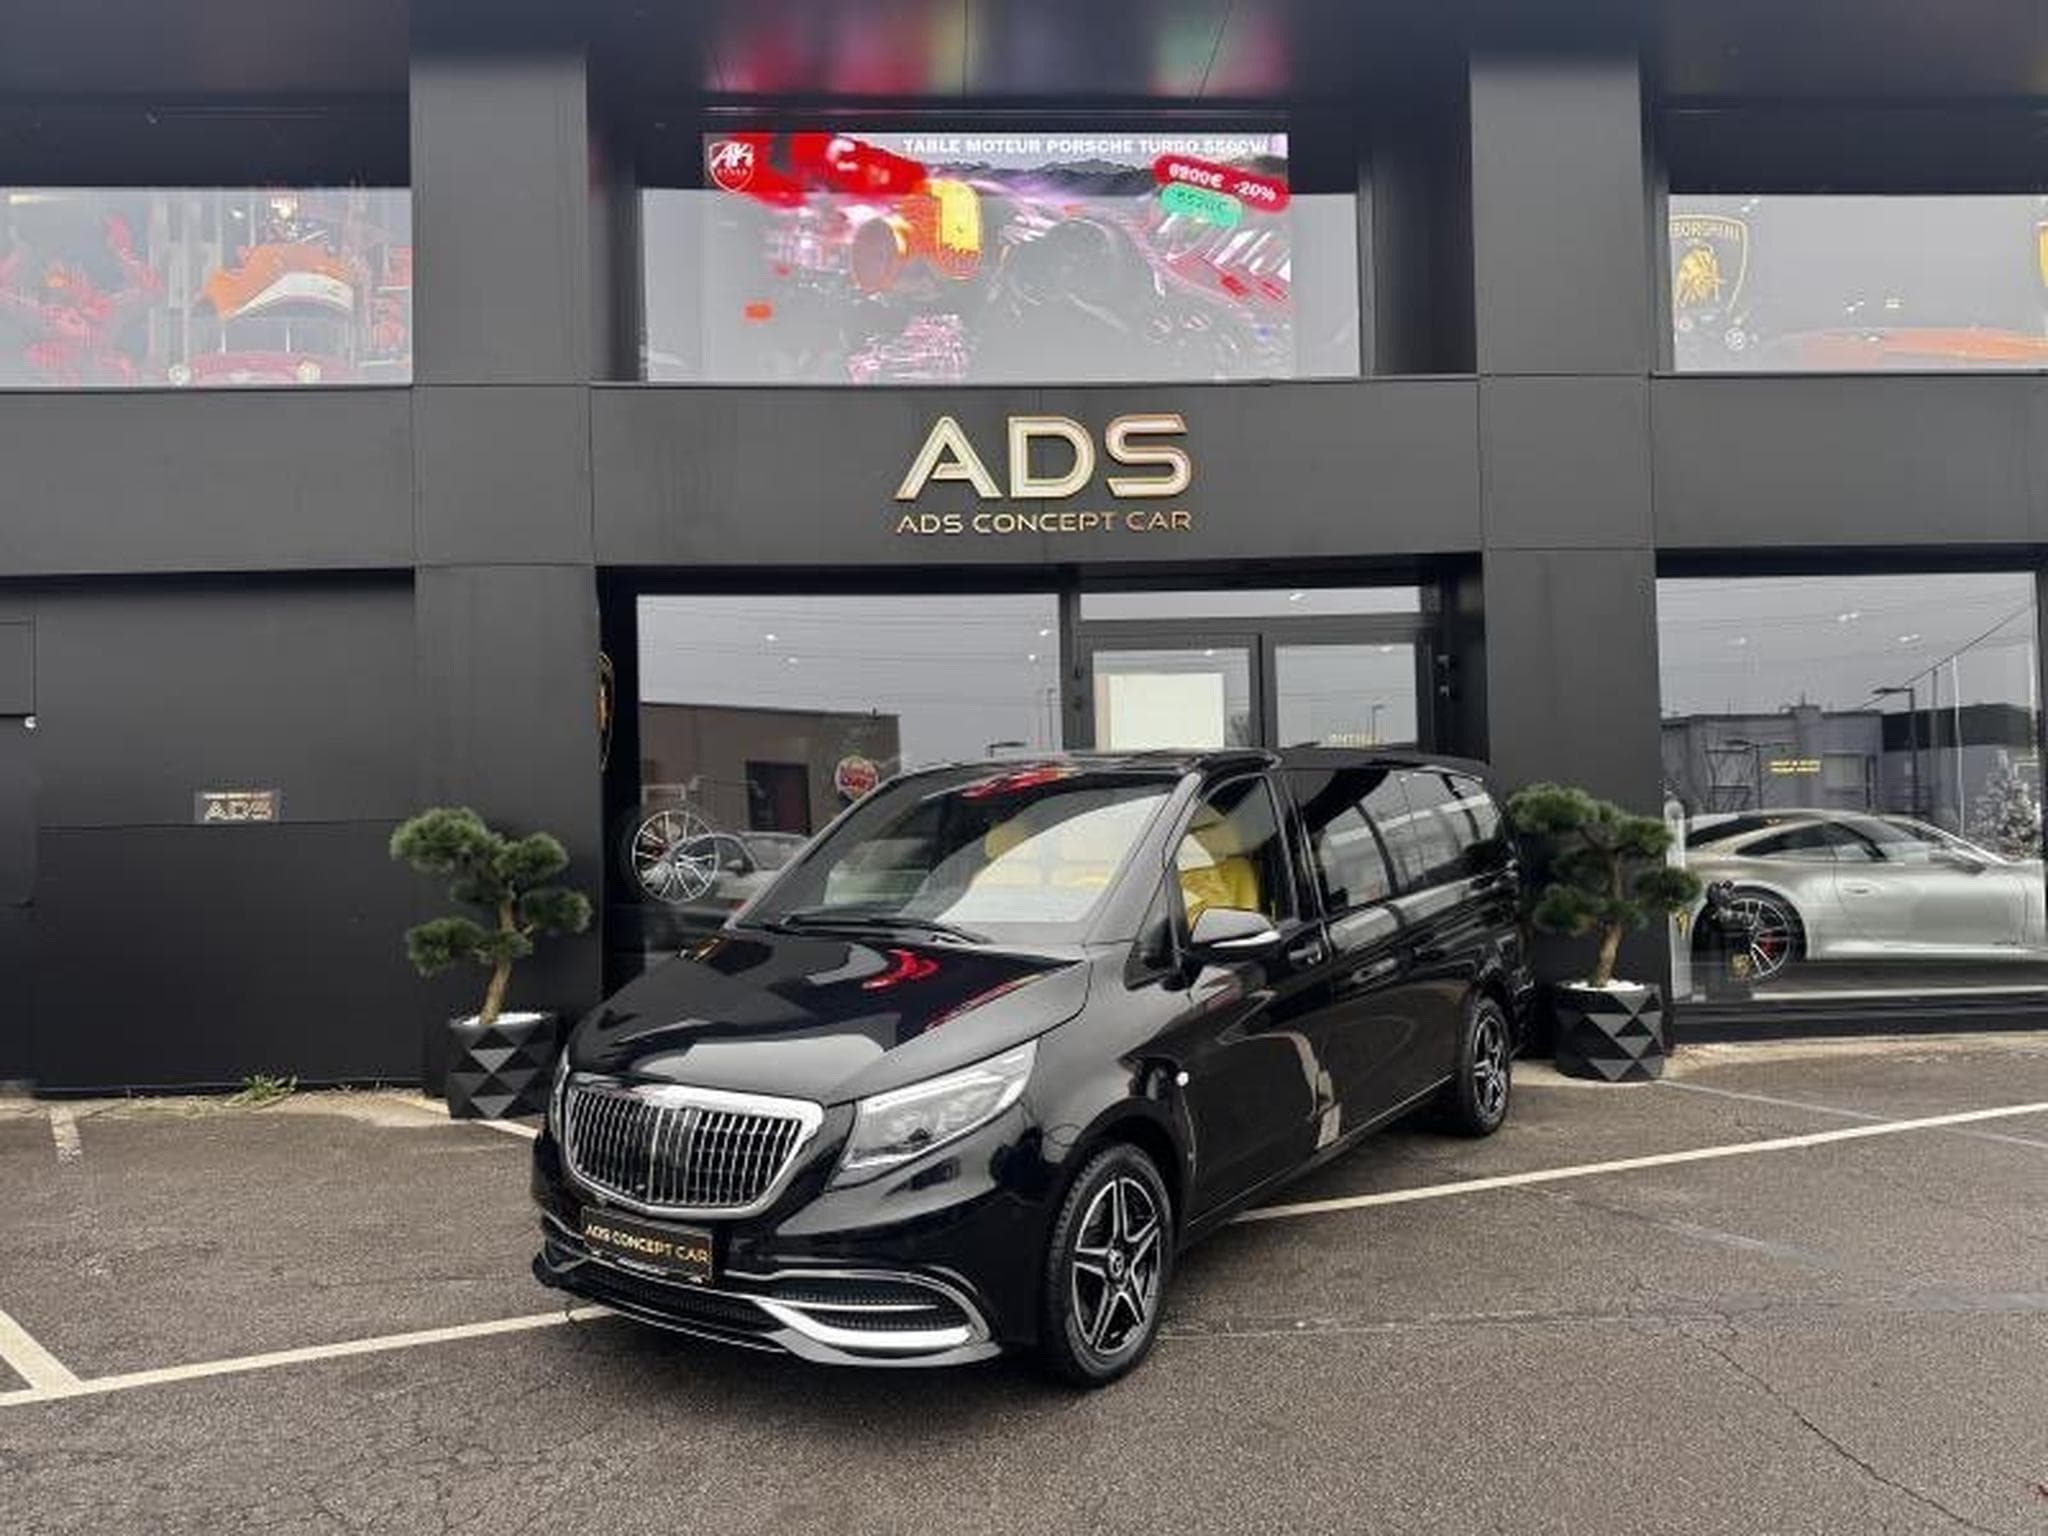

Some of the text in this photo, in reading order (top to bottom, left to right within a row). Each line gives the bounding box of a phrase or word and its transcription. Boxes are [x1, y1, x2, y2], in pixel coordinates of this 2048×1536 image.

[965, 138, 1041, 153] MOTEUR
[1046, 138, 1132, 153] PORSCHE
[894, 413, 1193, 500] ADS
[896, 511, 1193, 534] ADS CONCEPT CAR
[204, 800, 272, 820] ADS
[585, 1223, 708, 1263] ADS CONCEPT CAR
